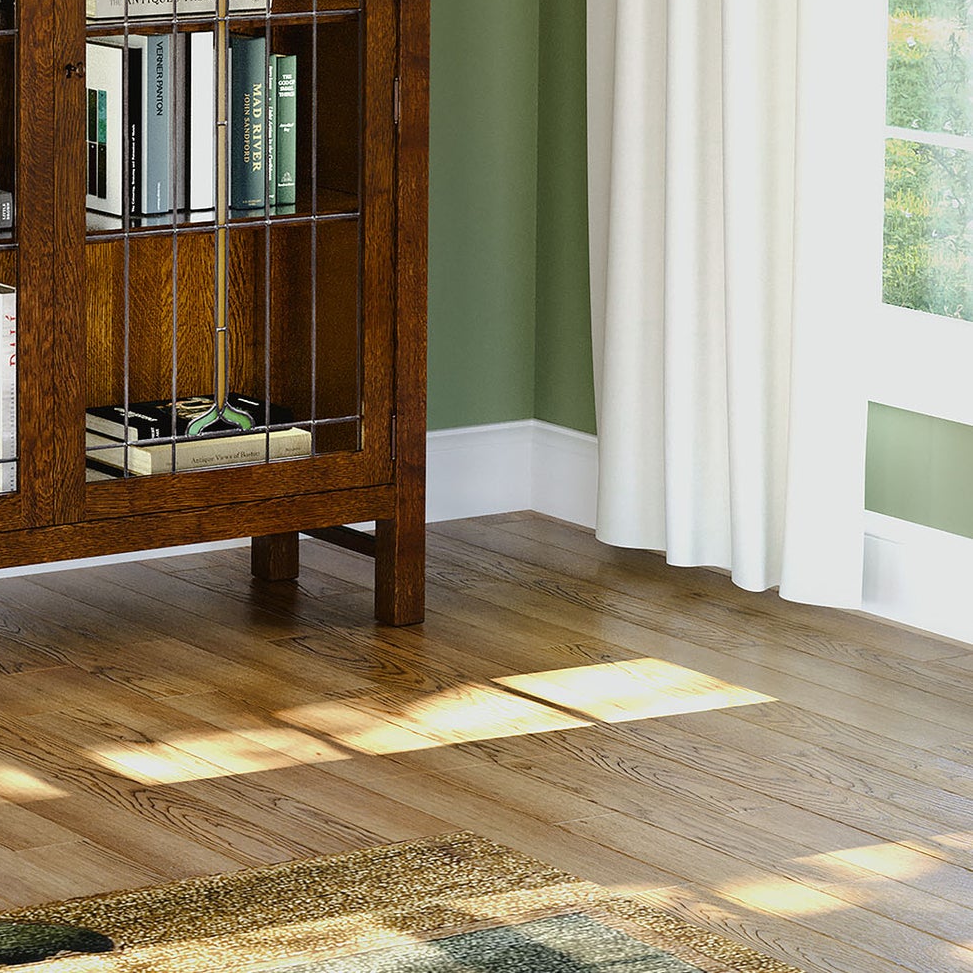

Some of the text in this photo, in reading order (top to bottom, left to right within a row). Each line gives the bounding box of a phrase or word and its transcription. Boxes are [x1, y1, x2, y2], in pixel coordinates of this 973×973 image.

[156, 40, 164, 117] VERNER PANTON
[243, 93, 251, 164] JOHN SANDFORD
[252, 83, 262, 172] MAD RIVER
